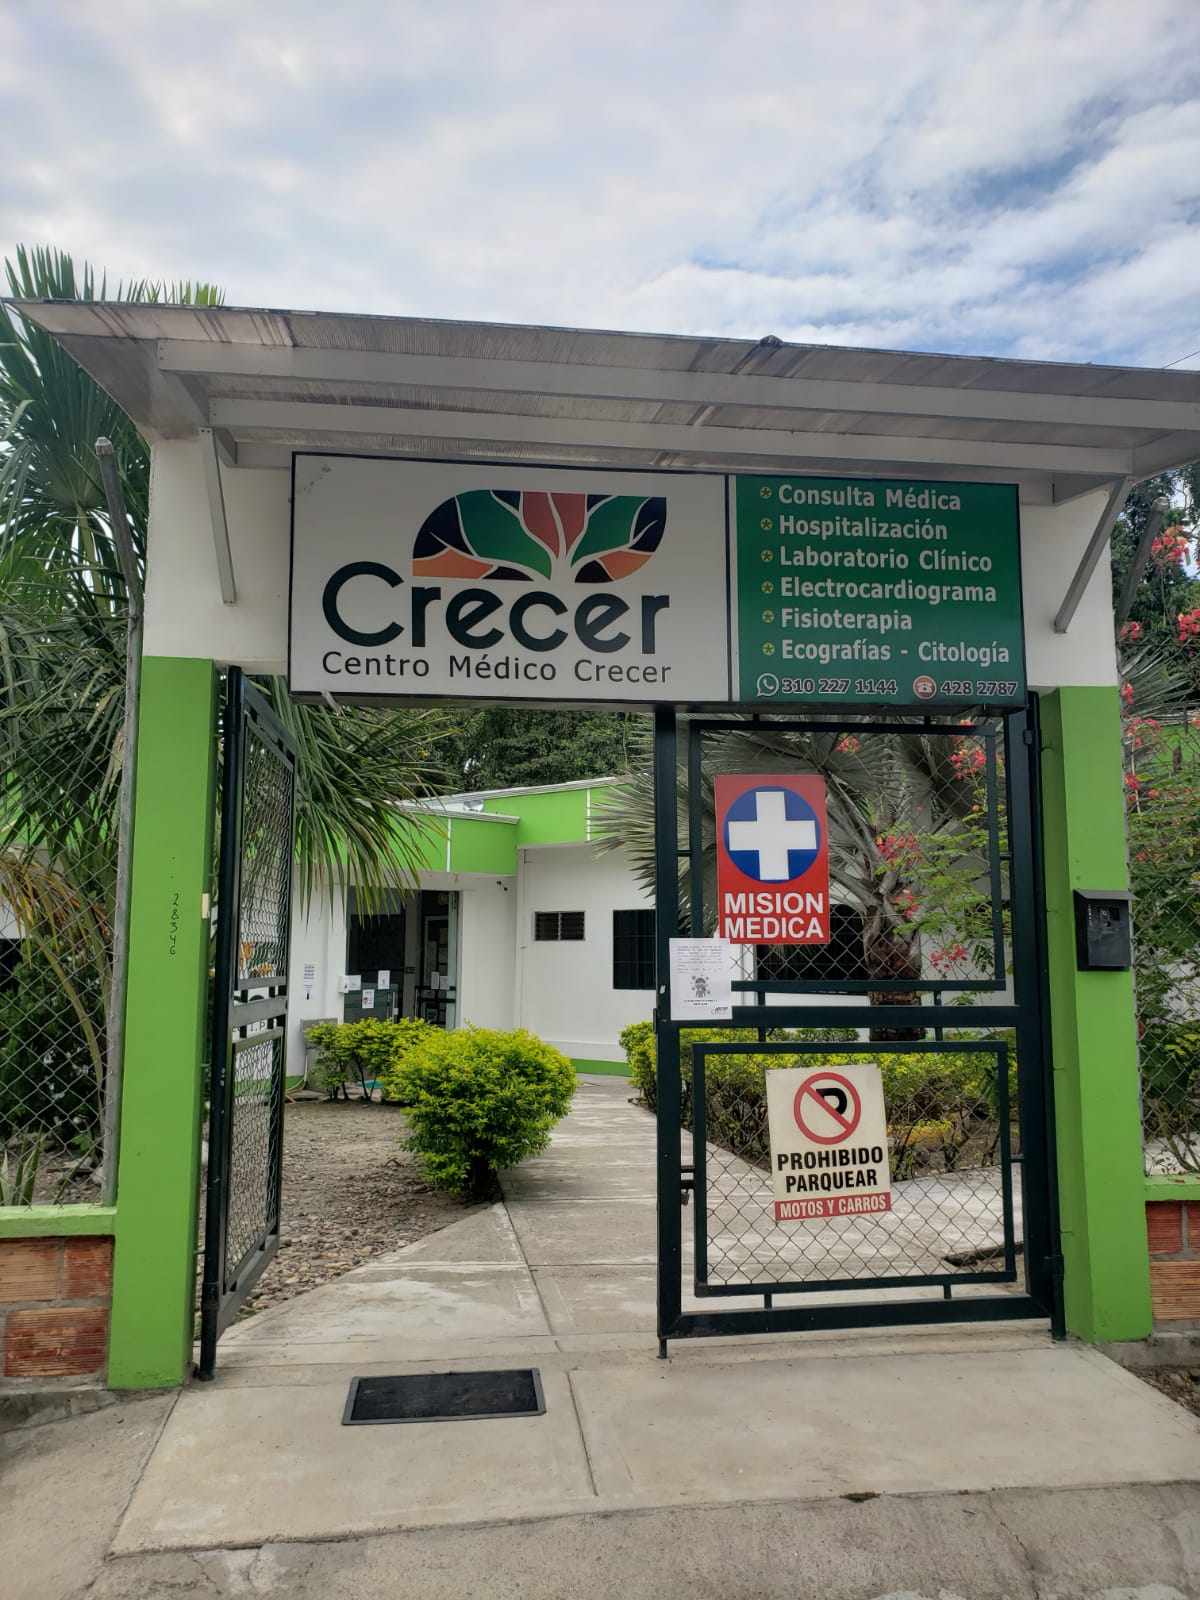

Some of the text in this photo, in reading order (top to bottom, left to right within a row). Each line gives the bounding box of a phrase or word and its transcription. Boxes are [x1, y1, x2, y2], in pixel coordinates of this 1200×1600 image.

[778, 484, 961, 510] Consulta Médica
[779, 515, 948, 540] Hospitalización
[780, 546, 992, 572] Laboratorio Clínico
[781, 577, 997, 605] Electrocardiograma
[322, 561, 670, 654] Crecer
[781, 608, 912, 634] Fisioterapia
[782, 638, 891, 664] Ecografías
[918, 641, 1010, 667] Citología
[322, 651, 672, 683] Centro Médico Crecer
[782, 679, 1017, 697] 310 227 1144 428 2787
[725, 893, 823, 914] MISION
[725, 917, 824, 939] MEDICA
[777, 1146, 883, 1171] PROHIBIDO
[785, 1169, 878, 1193] PARQUEAR
[780, 1194, 886, 1218] MOTOS Y CARROS
